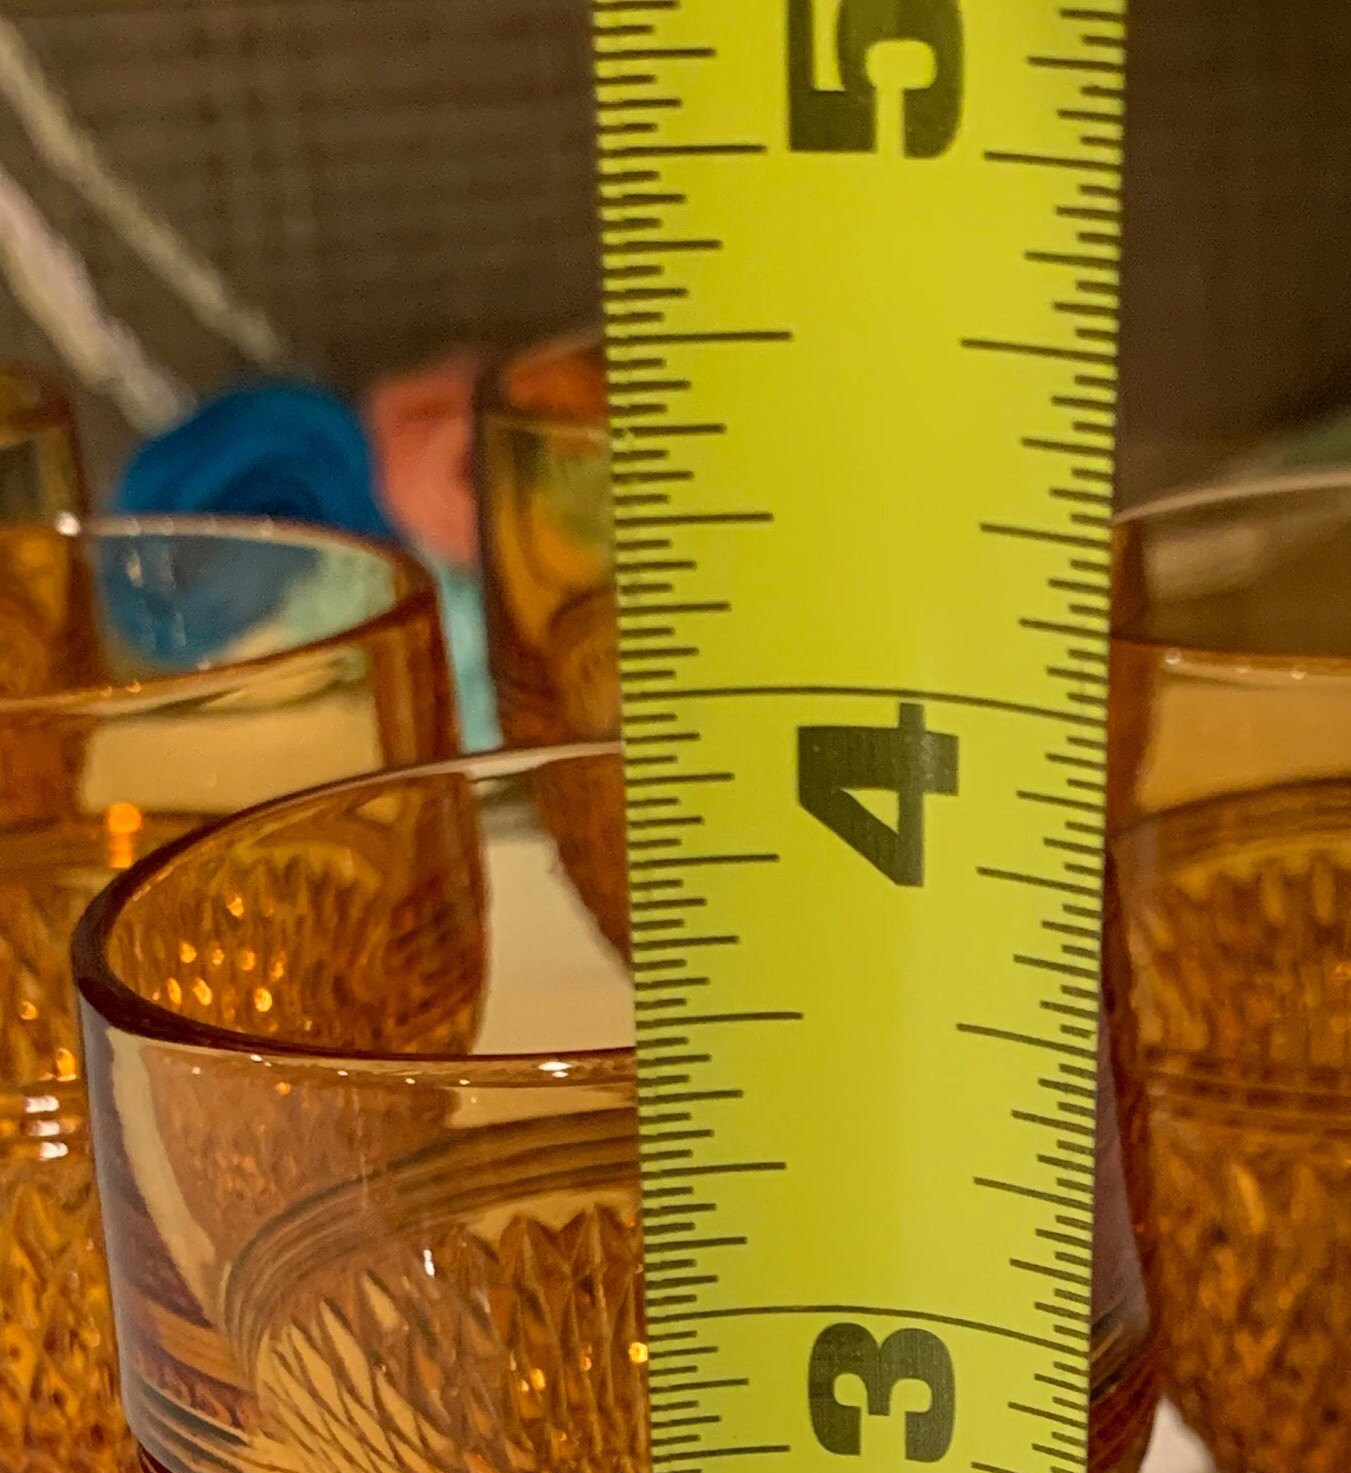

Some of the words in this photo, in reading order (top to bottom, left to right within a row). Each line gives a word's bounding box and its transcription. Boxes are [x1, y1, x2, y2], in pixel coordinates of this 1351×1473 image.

[786, 0, 965, 159] 5
[796, 702, 959, 887] 4
[808, 1321, 956, 1464] 3
